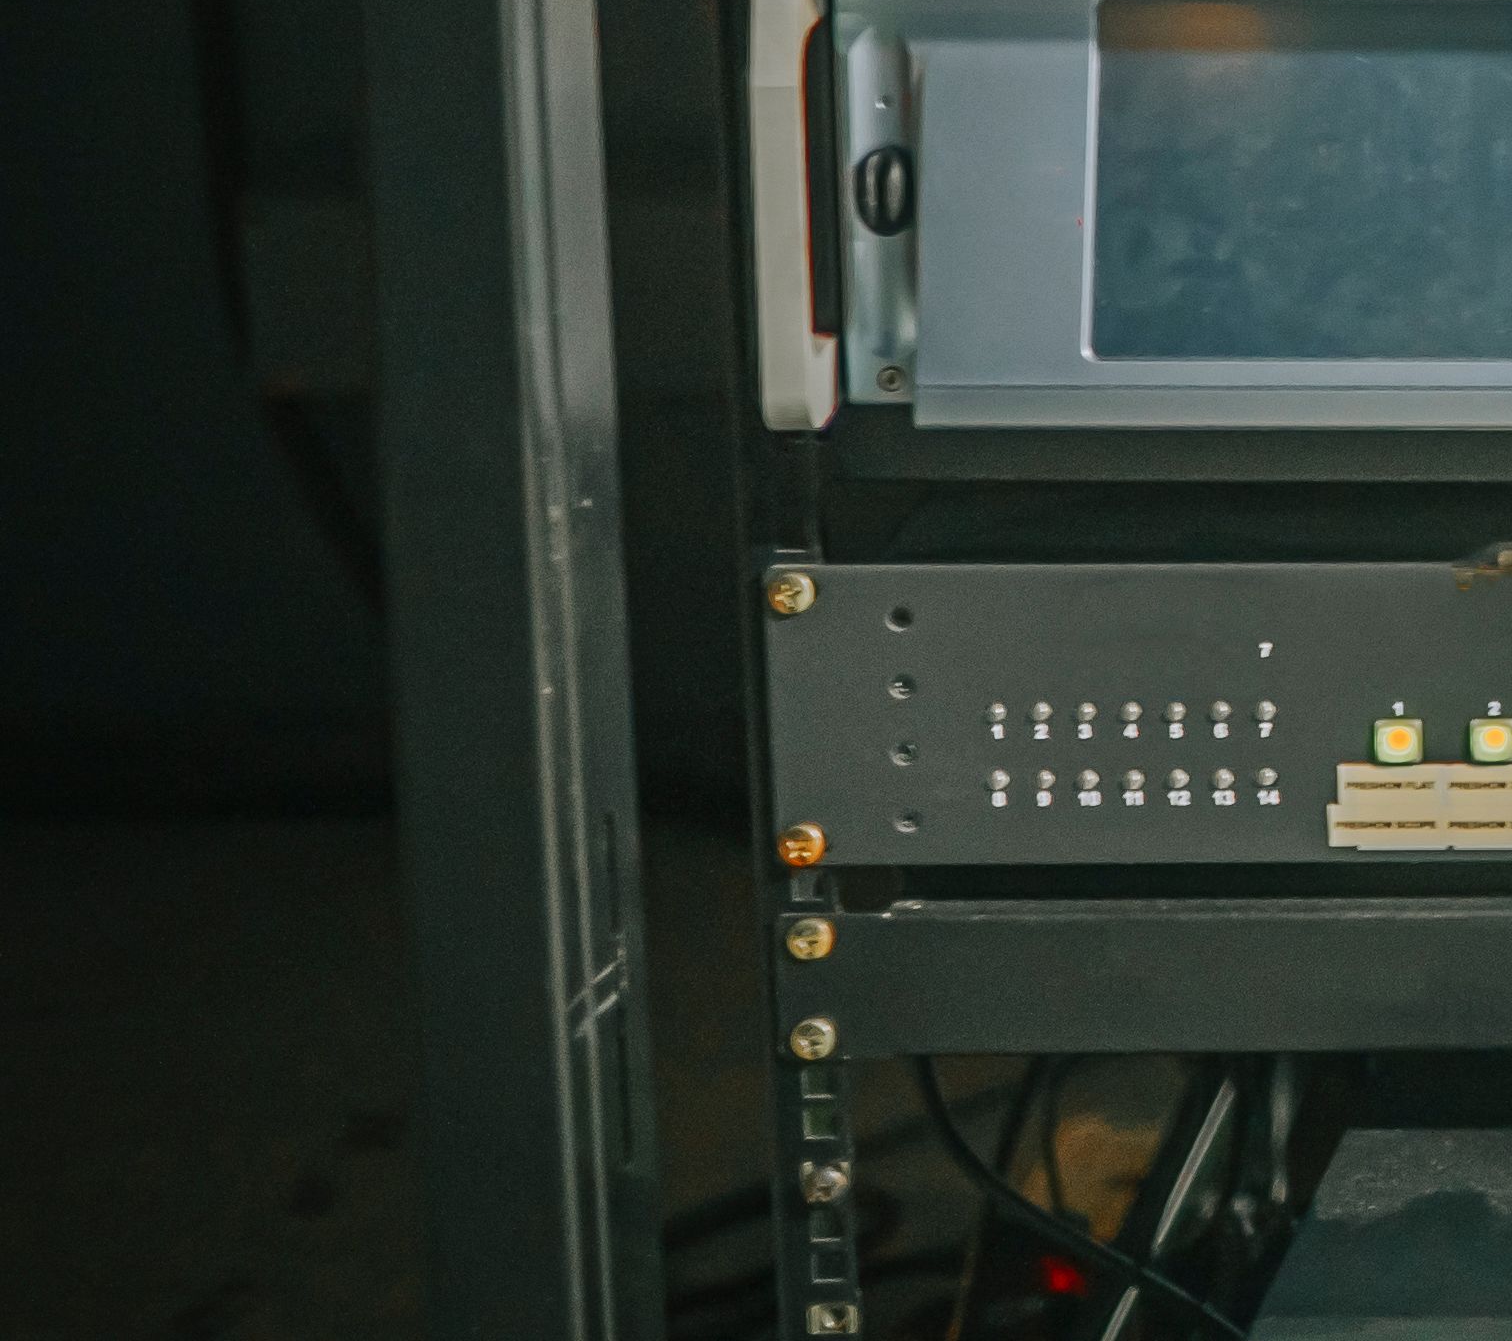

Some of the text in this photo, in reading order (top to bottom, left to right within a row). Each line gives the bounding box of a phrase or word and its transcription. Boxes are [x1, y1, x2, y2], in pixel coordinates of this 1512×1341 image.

[1258, 642, 1274, 659] 7
[1391, 701, 1404, 716] 1
[1487, 700, 1502, 716] 2
[990, 721, 1274, 740] 1 2 3 4 5 6 7
[991, 789, 1281, 808] 8 9 10 11 12 13 14
